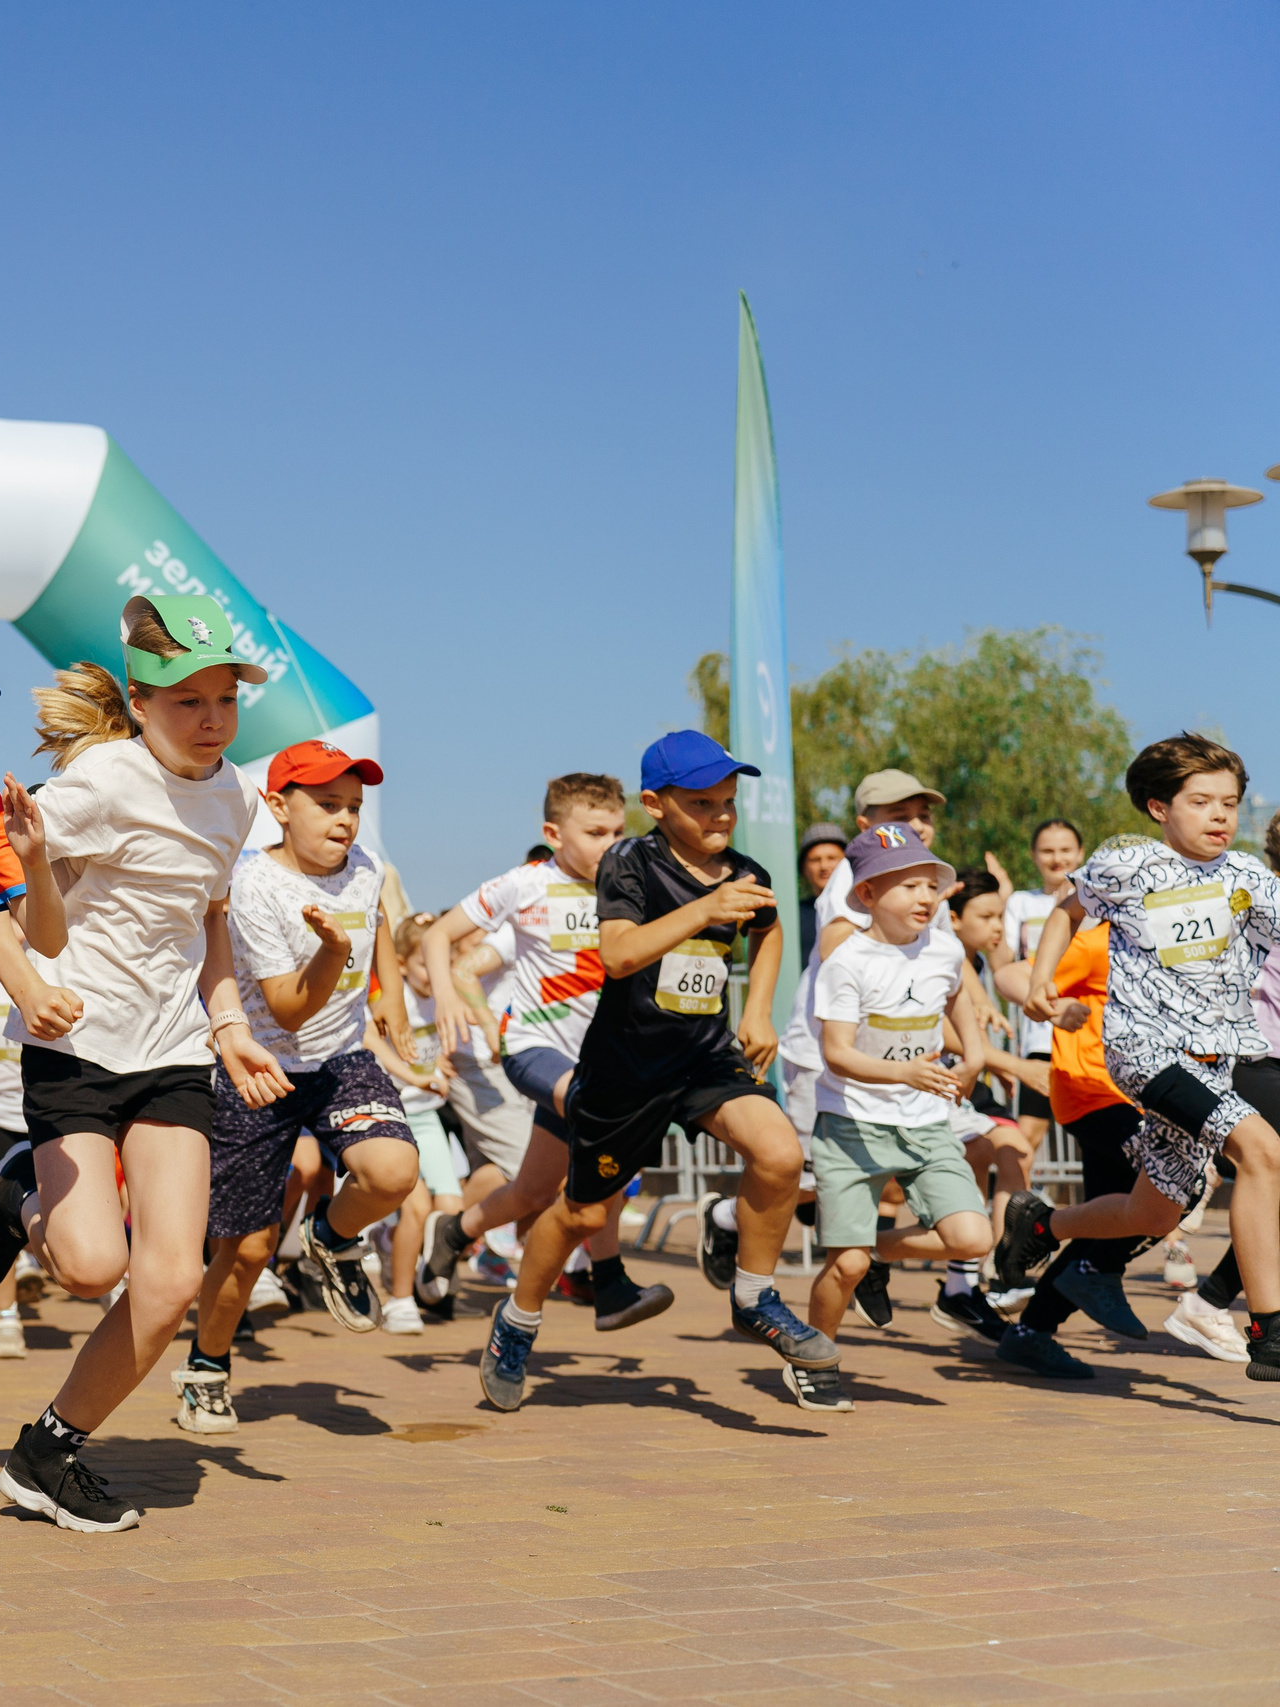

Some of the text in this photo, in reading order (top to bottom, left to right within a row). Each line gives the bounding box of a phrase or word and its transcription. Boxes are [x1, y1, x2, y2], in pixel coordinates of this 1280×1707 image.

[1172, 917, 1215, 943] 221
[571, 935, 591, 946] 500
[1183, 945, 1206, 959] 500
[678, 972, 716, 994] 680
[679, 998, 699, 1009] 500
[42, 1408, 88, 1446] NYC
